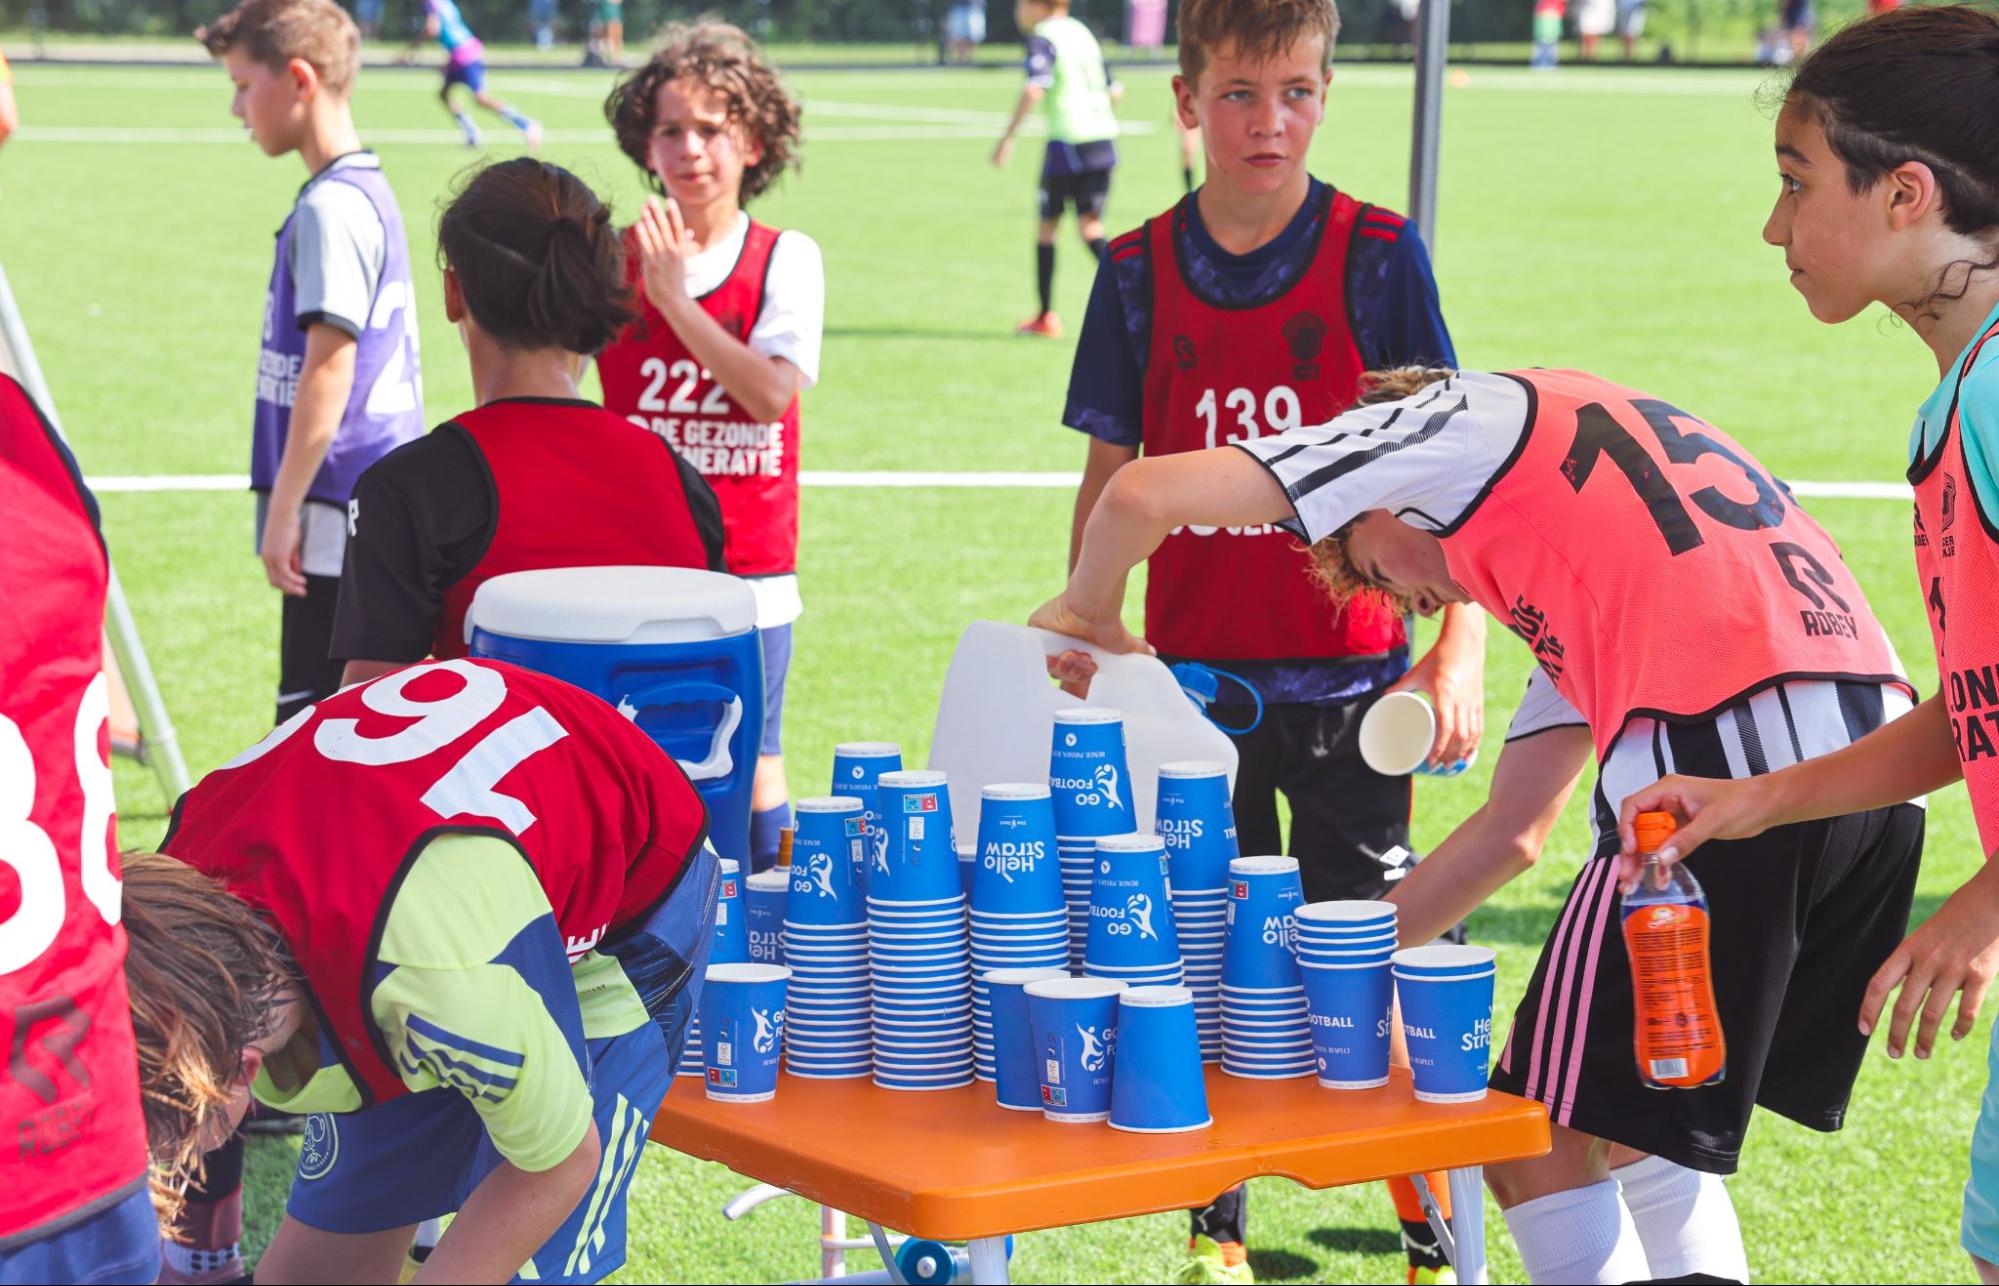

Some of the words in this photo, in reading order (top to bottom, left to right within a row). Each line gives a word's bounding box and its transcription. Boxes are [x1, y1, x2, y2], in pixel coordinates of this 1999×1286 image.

[1195, 385, 1302, 450] 139
[683, 420, 785, 449] GEZONDE
[1800, 610, 1859, 640] ROBEY
[1951, 663, 1999, 713] ON
[222, 659, 569, 836] 16
[1075, 793, 1101, 806] GO
[985, 841, 1045, 859] Straw
[984, 856, 1035, 883] Hello
[794, 879, 813, 893] GO
[1107, 922, 1132, 936] GO
[1263, 915, 1297, 930] aw
[1262, 929, 1299, 954] ello
